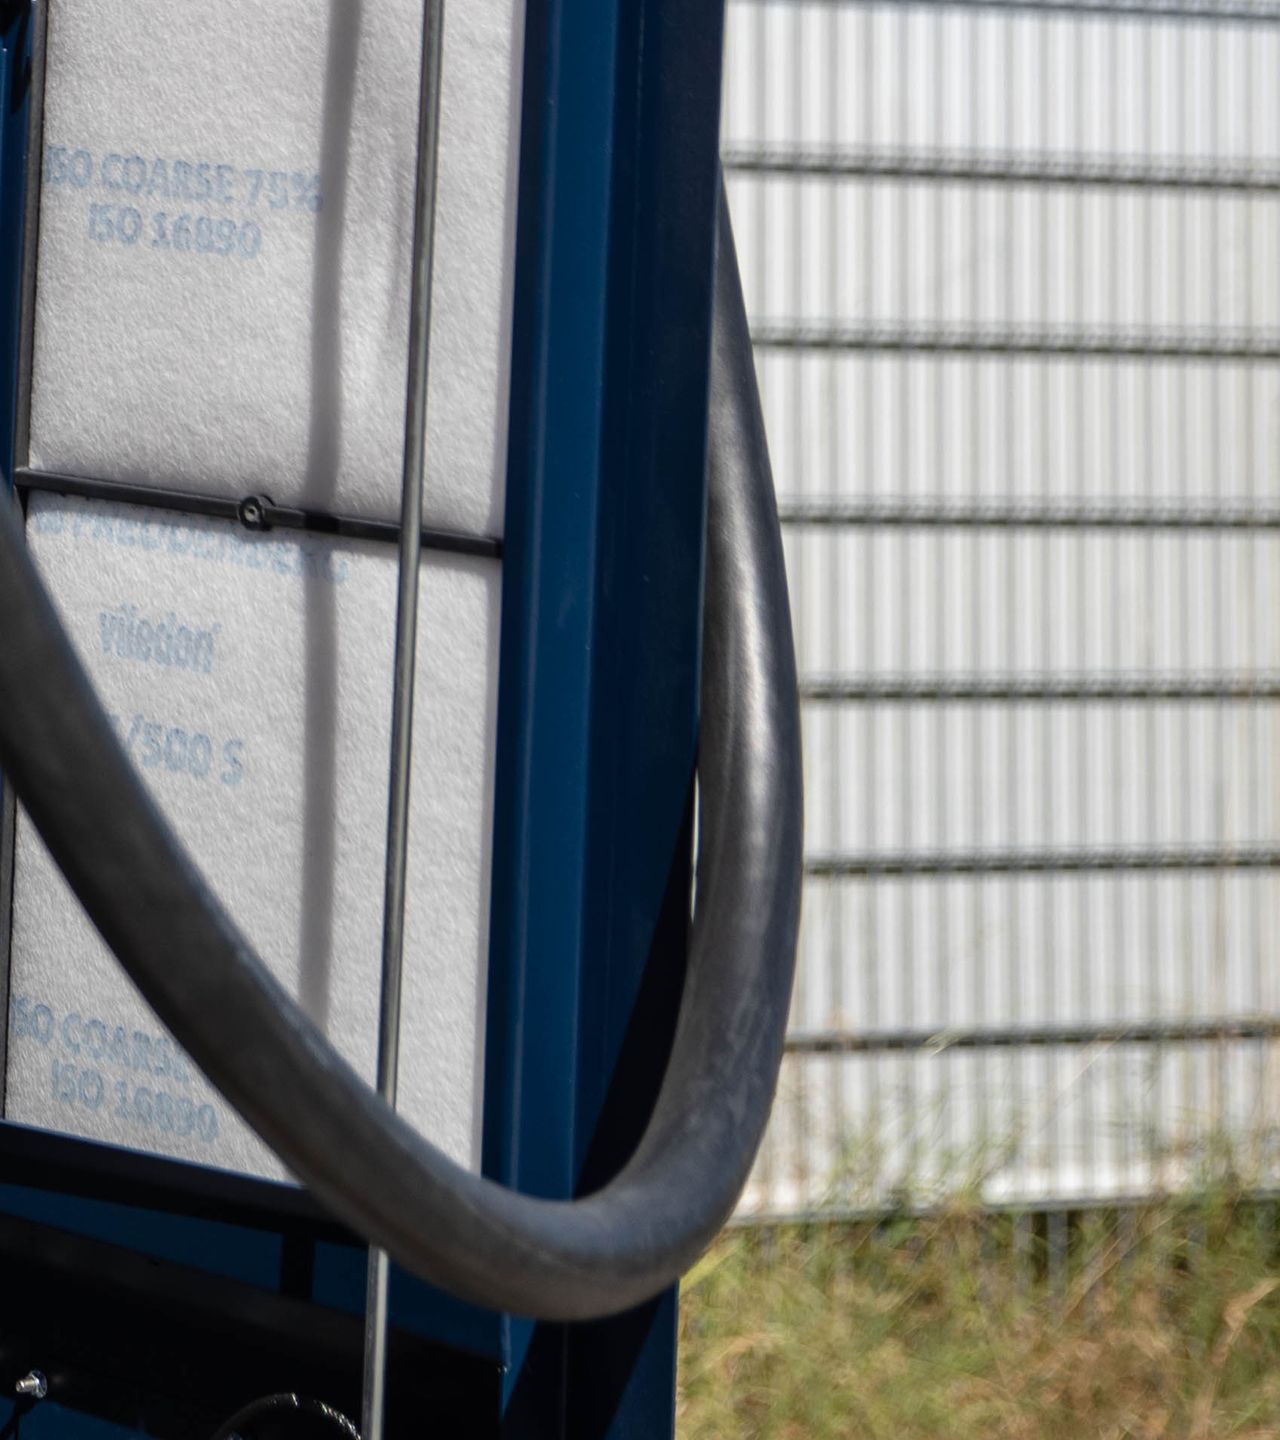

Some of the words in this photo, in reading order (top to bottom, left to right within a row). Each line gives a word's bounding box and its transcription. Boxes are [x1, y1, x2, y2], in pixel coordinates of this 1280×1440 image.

[100, 152, 235, 206] COARSE
[87, 201, 143, 248] ISO
[219, 736, 245, 785] S
